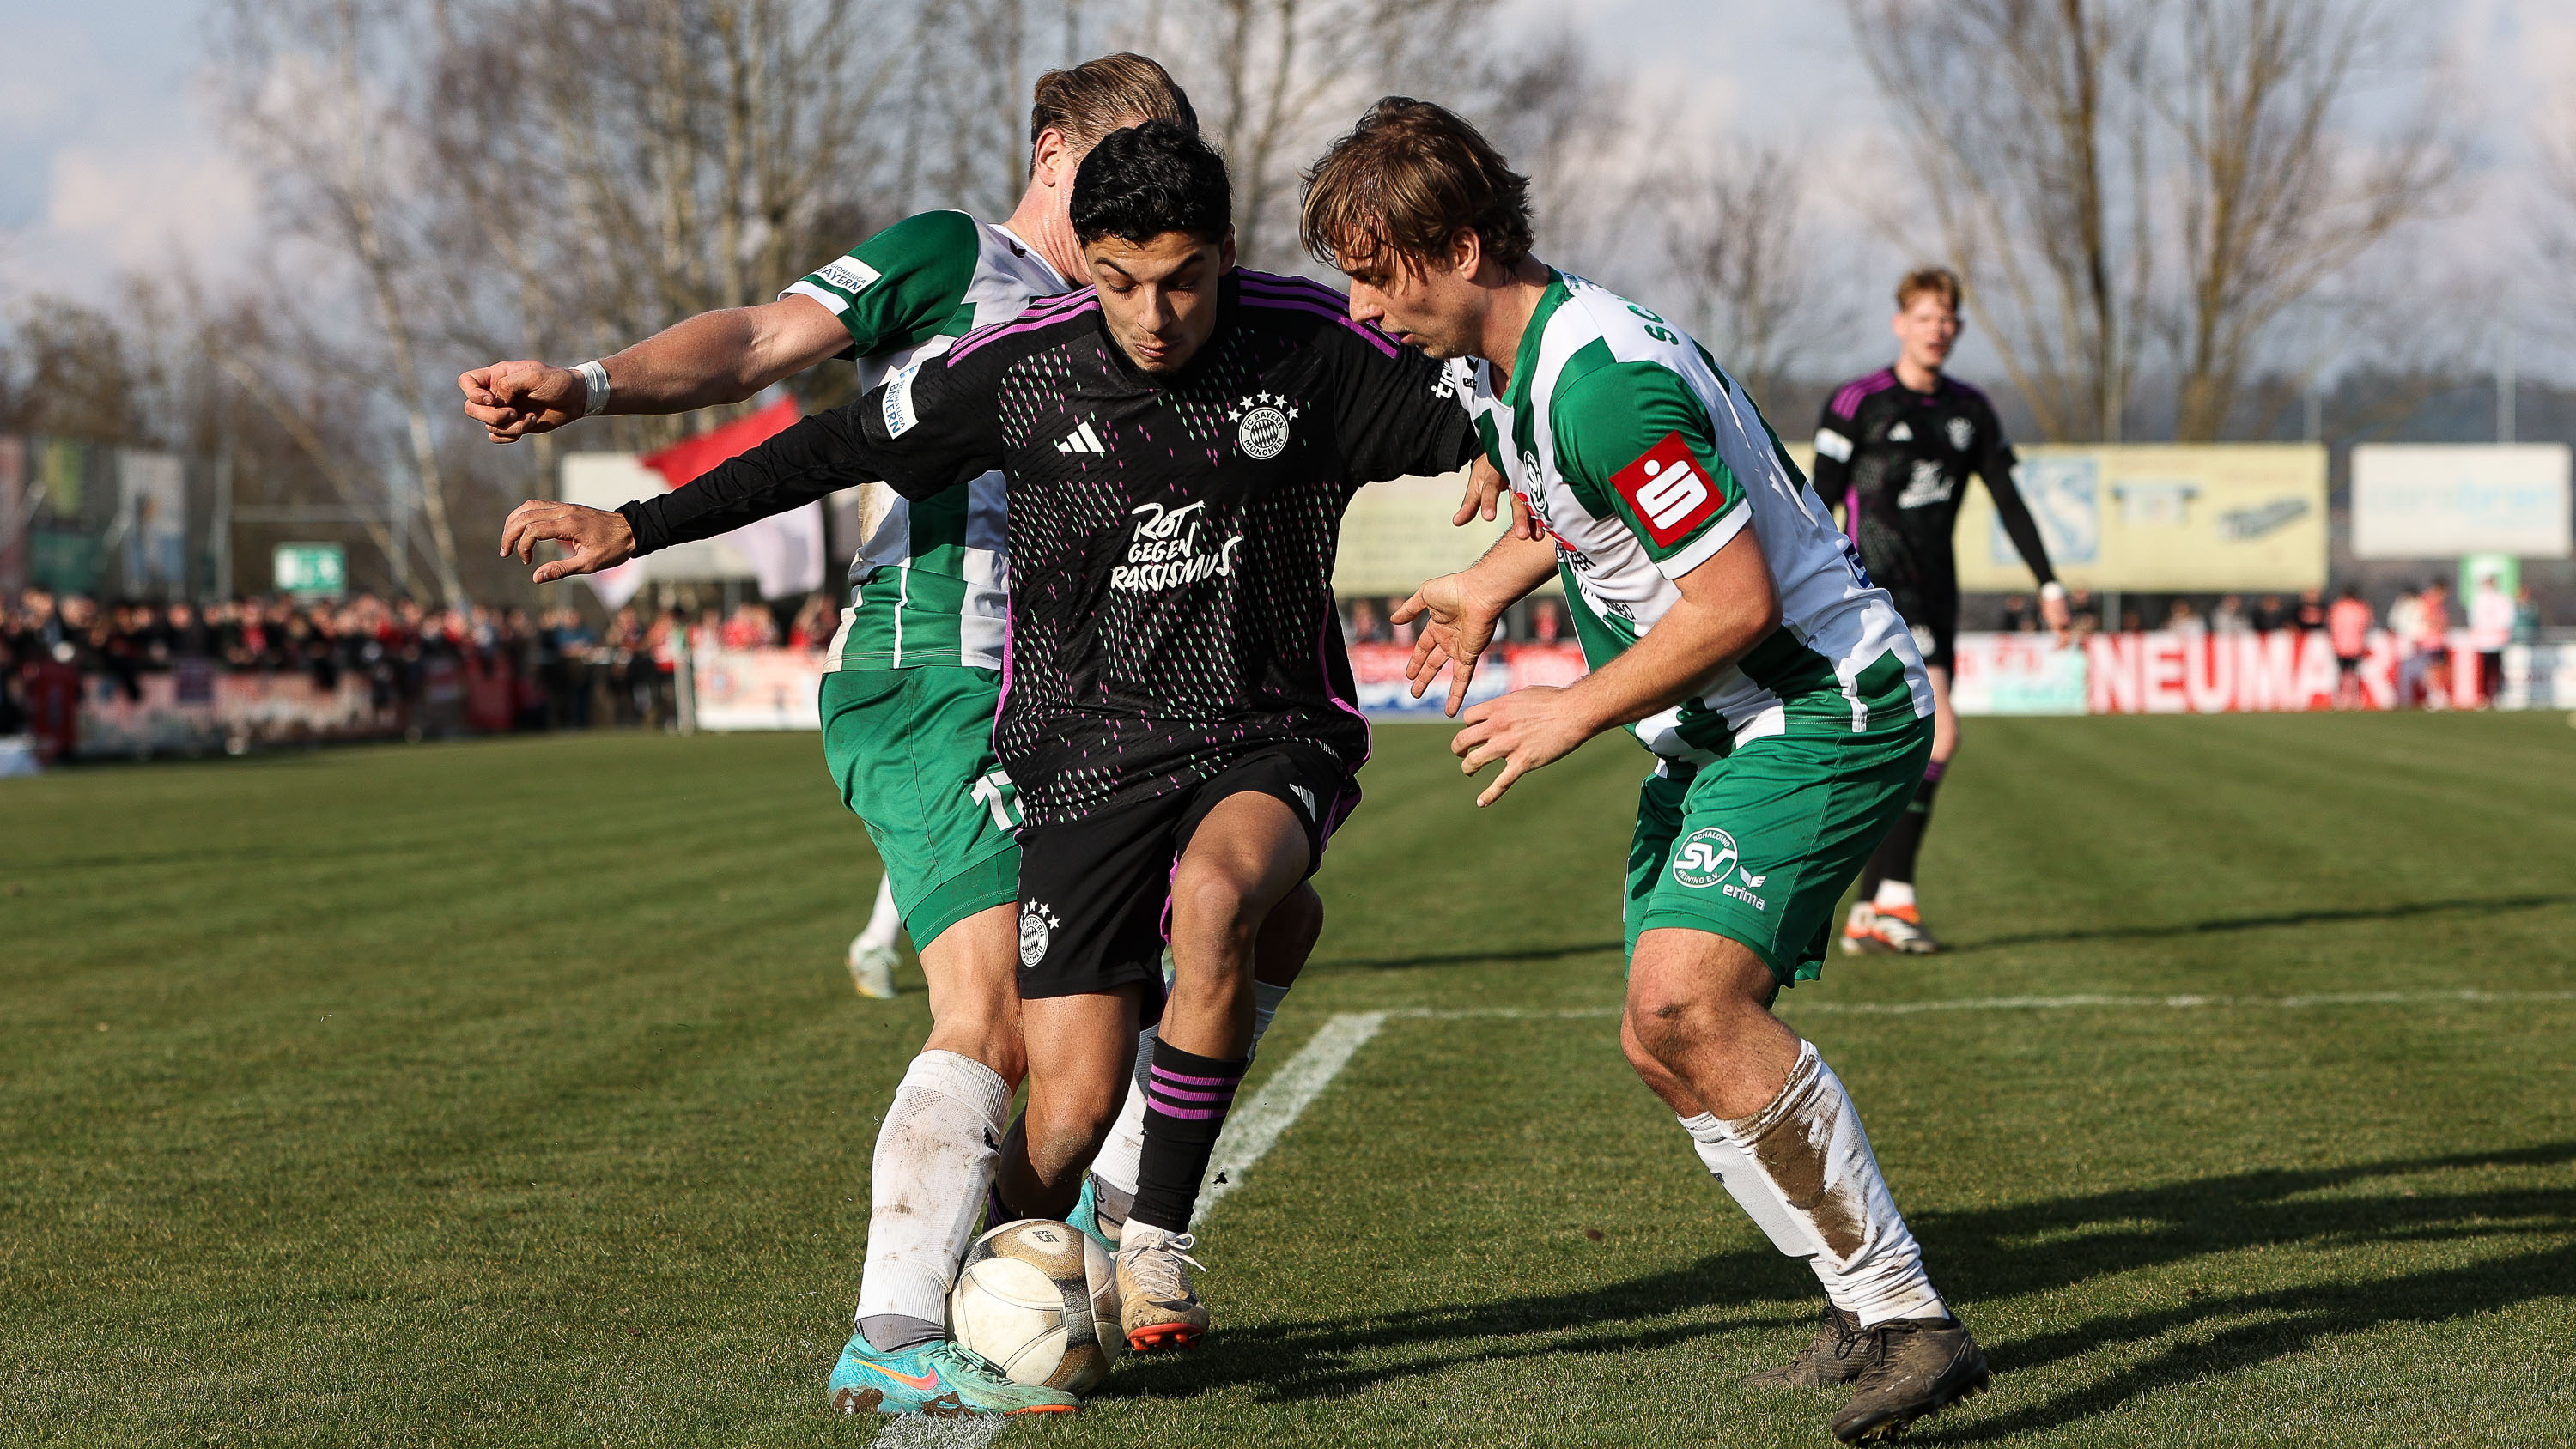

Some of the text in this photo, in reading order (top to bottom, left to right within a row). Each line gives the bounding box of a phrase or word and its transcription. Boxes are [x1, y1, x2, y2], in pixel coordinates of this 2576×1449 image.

[885, 383, 901, 433] BAYERN
[1244, 412, 1285, 431] FC BAYERN
[1132, 500, 1205, 542] ROT
[1128, 522, 1196, 563] GEGEN
[1111, 536, 1242, 591] RASSISMUS
[1692, 830, 1731, 847] SCHALDING
[1675, 841, 1735, 873] SV
[1677, 869, 1704, 884] HEINING
[1722, 883, 1766, 910] erima
